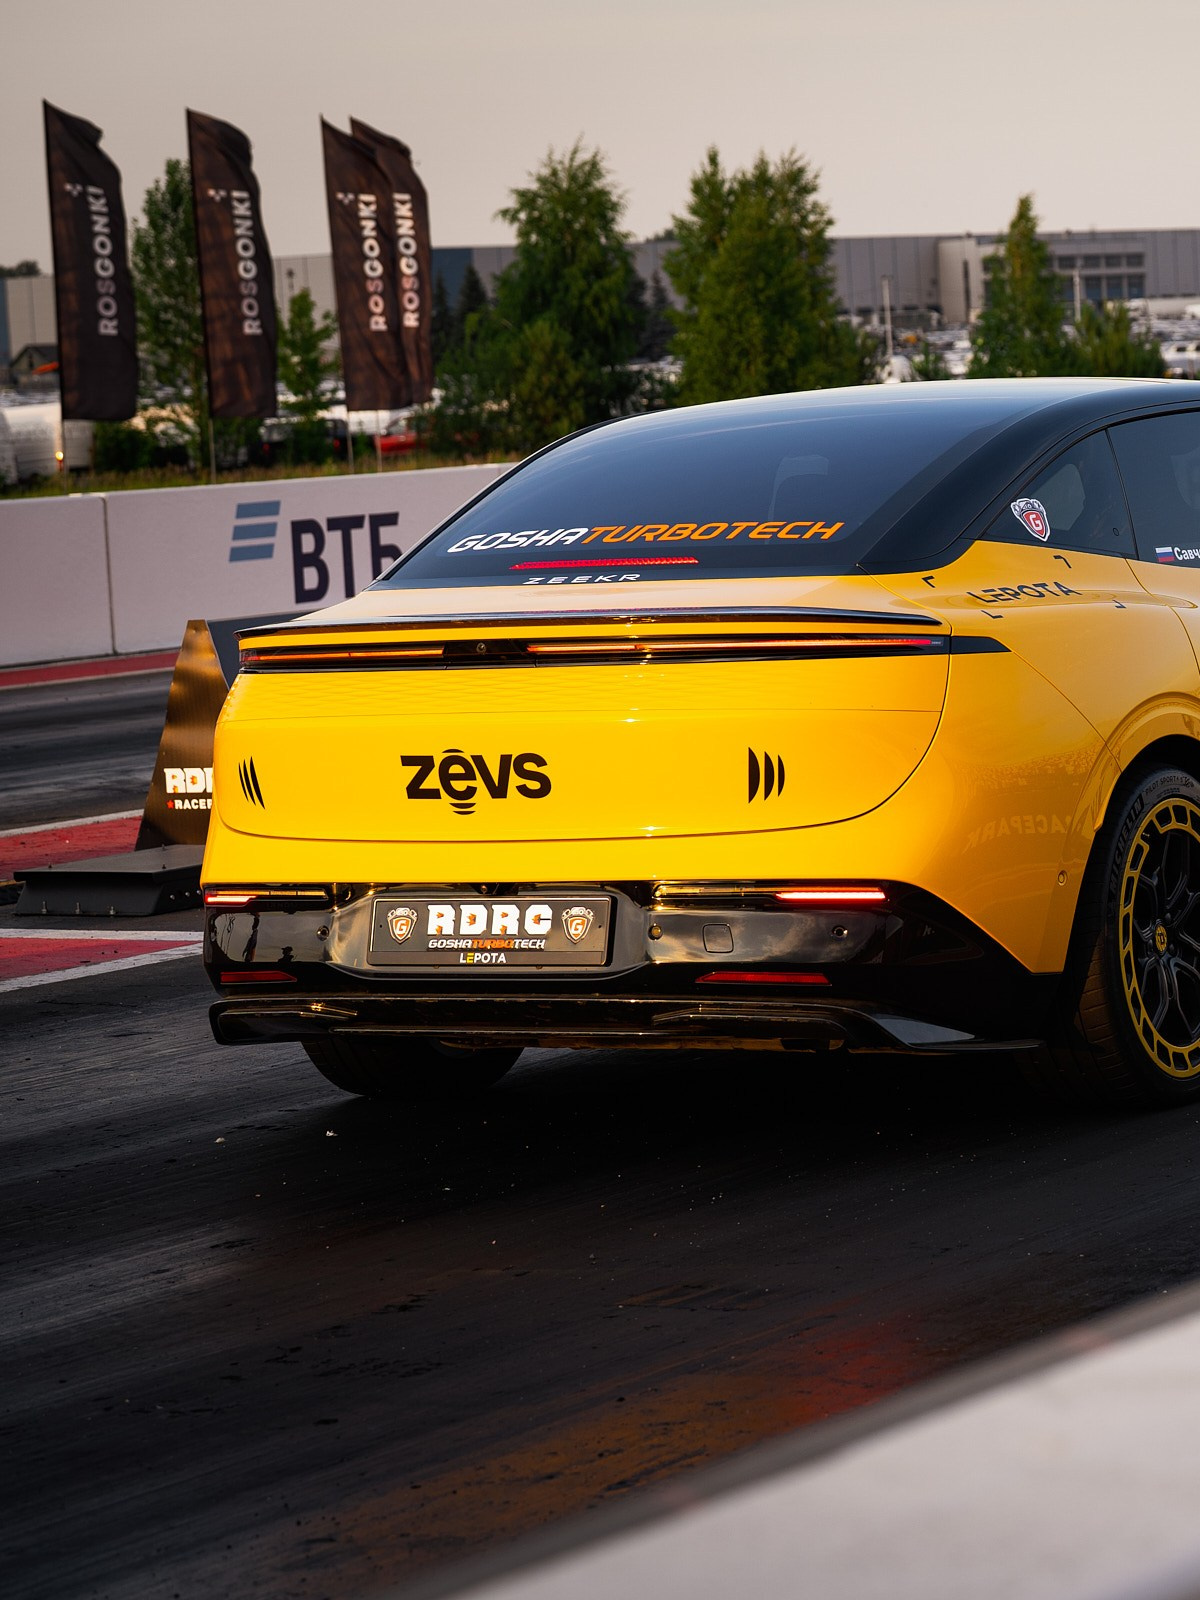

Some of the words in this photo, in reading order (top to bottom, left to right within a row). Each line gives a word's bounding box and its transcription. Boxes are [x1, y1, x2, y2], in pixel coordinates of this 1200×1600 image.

[87, 186, 118, 336] ROSGONKI
[232, 189, 263, 335] ROSGONKI
[358, 193, 388, 332] ROSGONKI
[393, 191, 420, 328] ROSGONKI
[447, 520, 844, 553] GOSHATURBOTECH
[522, 573, 641, 585] ZEEKR
[967, 581, 1082, 604] LEPOTA
[427, 904, 553, 936] RDRC
[459, 952, 507, 964] LEPOTA
